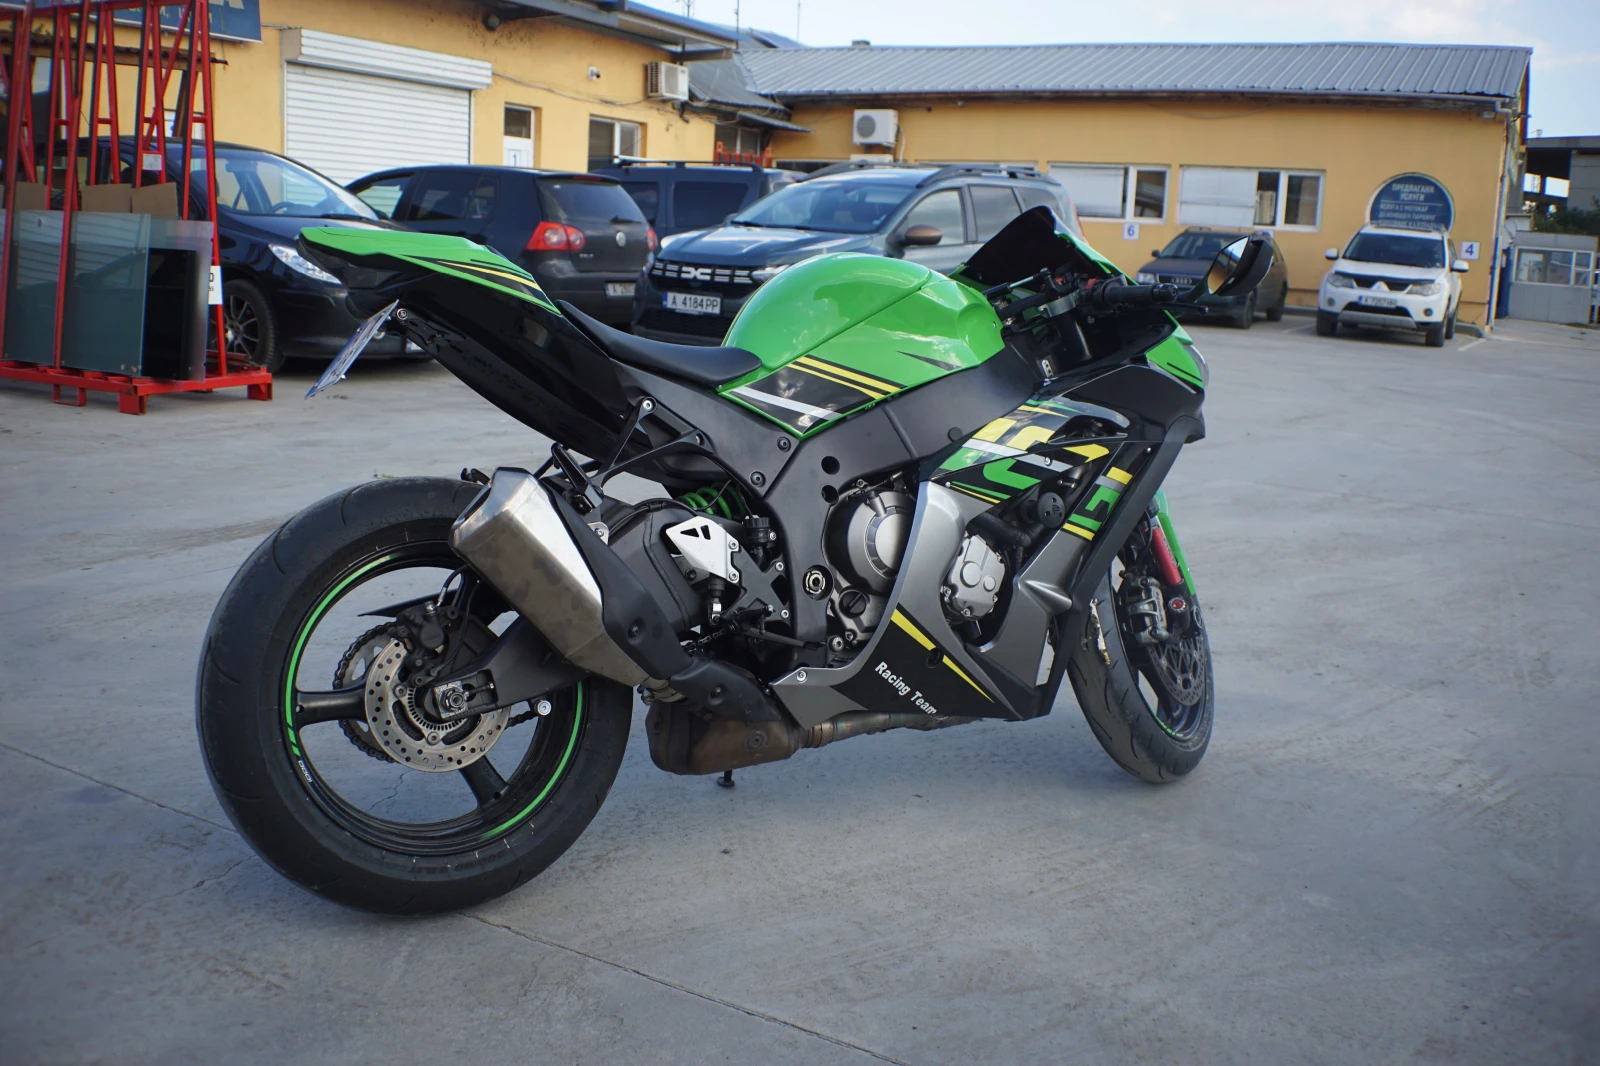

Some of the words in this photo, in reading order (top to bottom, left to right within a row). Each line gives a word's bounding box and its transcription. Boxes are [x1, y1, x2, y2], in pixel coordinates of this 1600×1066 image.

[1127, 224, 1135, 237] 6
[1465, 243, 1474, 256] 4
[671, 295, 677, 306] A
[681, 296, 704, 309] 4184
[875, 661, 911, 696] Racing
[910, 690, 937, 714] Team
